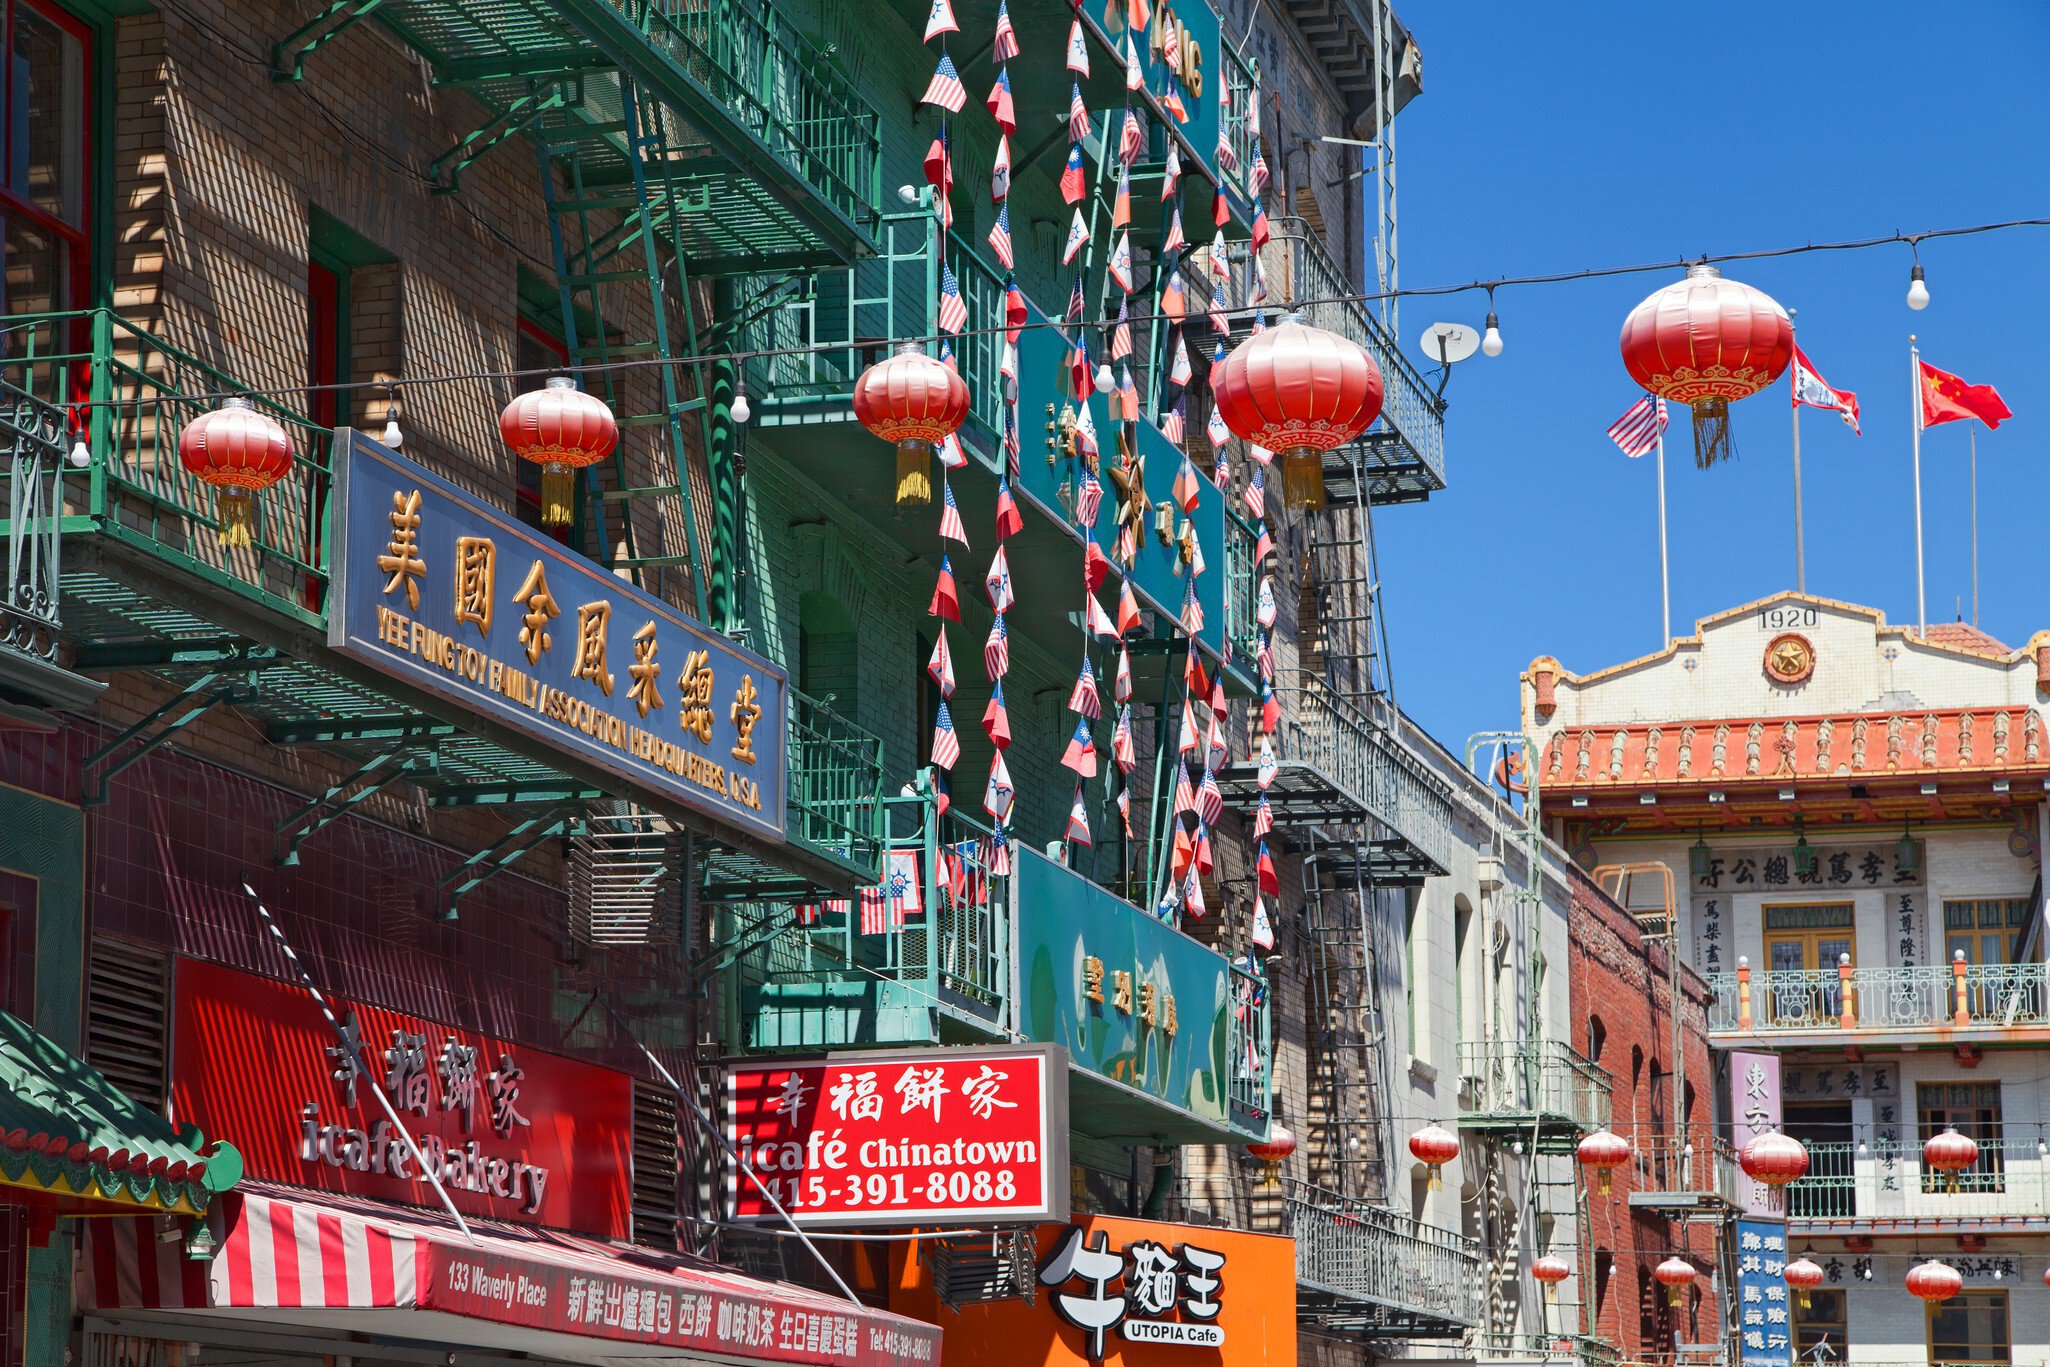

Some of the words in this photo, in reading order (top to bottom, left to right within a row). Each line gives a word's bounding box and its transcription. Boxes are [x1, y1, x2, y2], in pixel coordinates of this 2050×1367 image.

[1760, 608, 1817, 629] 1920
[376, 604, 410, 650] YEE
[411, 621, 455, 671] FUNG
[455, 643, 488, 685] TOY
[489, 658, 539, 709] FAMILY
[539, 684, 628, 751] ASSOCIATION
[629, 725, 729, 800] HEADQUARTERS,
[326, 1010, 531, 1138] 幸福餅家
[767, 1065, 1019, 1129] 幸福餅家
[740, 1129, 848, 1174] icafé
[859, 1137, 1037, 1167] Chinatown
[1745, 1062, 1769, 1206] 東方所
[417, 1132, 549, 1215] Bakery
[762, 1170, 1017, 1209] 415-391-8088
[448, 1260, 470, 1292] 133
[471, 1265, 515, 1309] Waverly
[516, 1275, 547, 1307] Place
[1040, 1224, 1227, 1362] 牛麵王
[567, 1276, 672, 1334] 新鮮出爐麵包
[678, 1293, 712, 1338] 西餅
[717, 1299, 775, 1348] 咖啡奶茶
[779, 1309, 858, 1358] 生日喜慶蛋糕
[869, 1328, 883, 1351] Tel:
[884, 1330, 932, 1361] 415-391-8088
[1131, 1323, 1185, 1341] UTOPIA
[1187, 1326, 1218, 1343] Cafe
